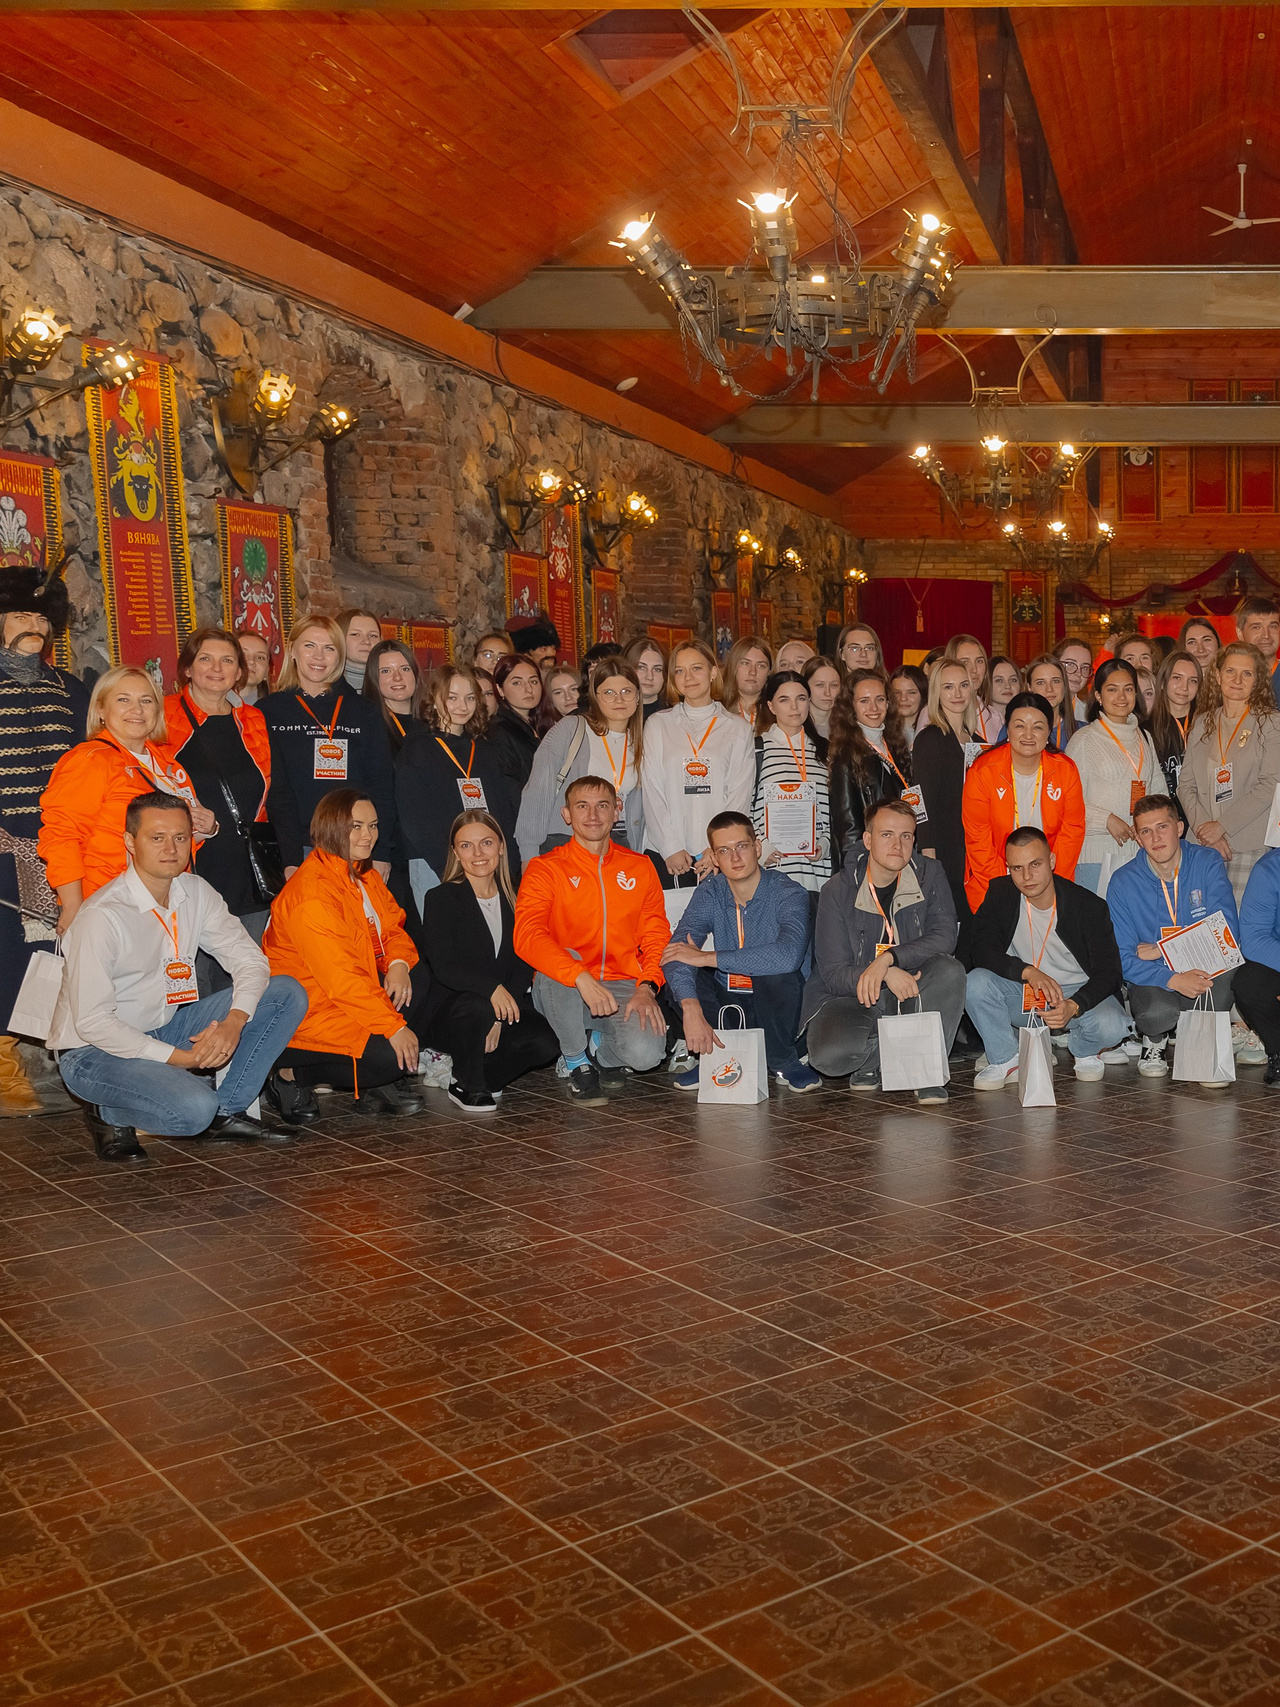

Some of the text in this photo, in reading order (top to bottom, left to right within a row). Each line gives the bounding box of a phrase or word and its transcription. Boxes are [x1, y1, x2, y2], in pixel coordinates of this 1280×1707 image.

[127, 531, 160, 545] ВЯНЯВА
[322, 725, 361, 734] HIFIGER
[1213, 929, 1229, 956] НАКАЗ
[168, 966, 189, 974] НОВОЕ
[168, 993, 197, 1002] УЧАСТНИК
